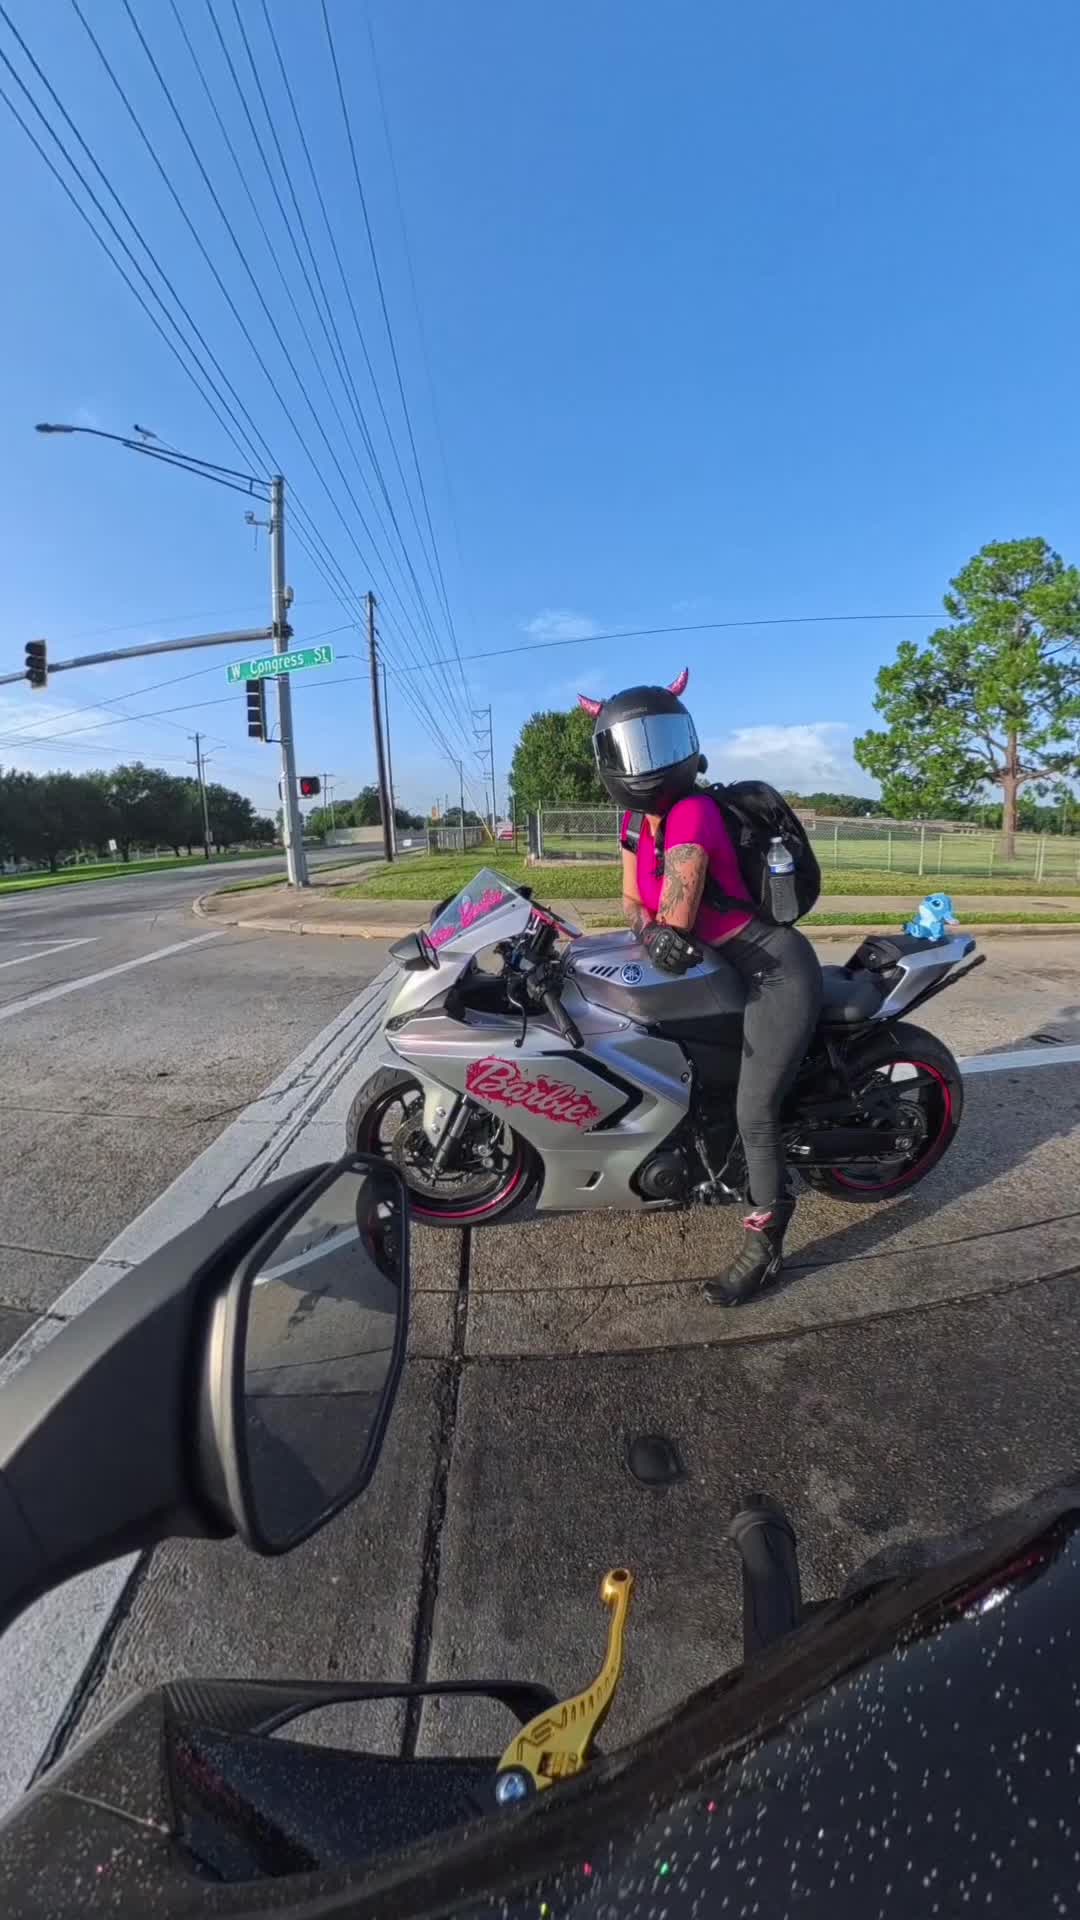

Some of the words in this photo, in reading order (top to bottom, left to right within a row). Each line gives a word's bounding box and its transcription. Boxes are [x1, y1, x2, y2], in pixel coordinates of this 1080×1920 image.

[230, 663, 241, 680] W
[250, 653, 304, 675] Congress
[313, 647, 329, 663] St
[469, 1057, 590, 1122] Barbie
